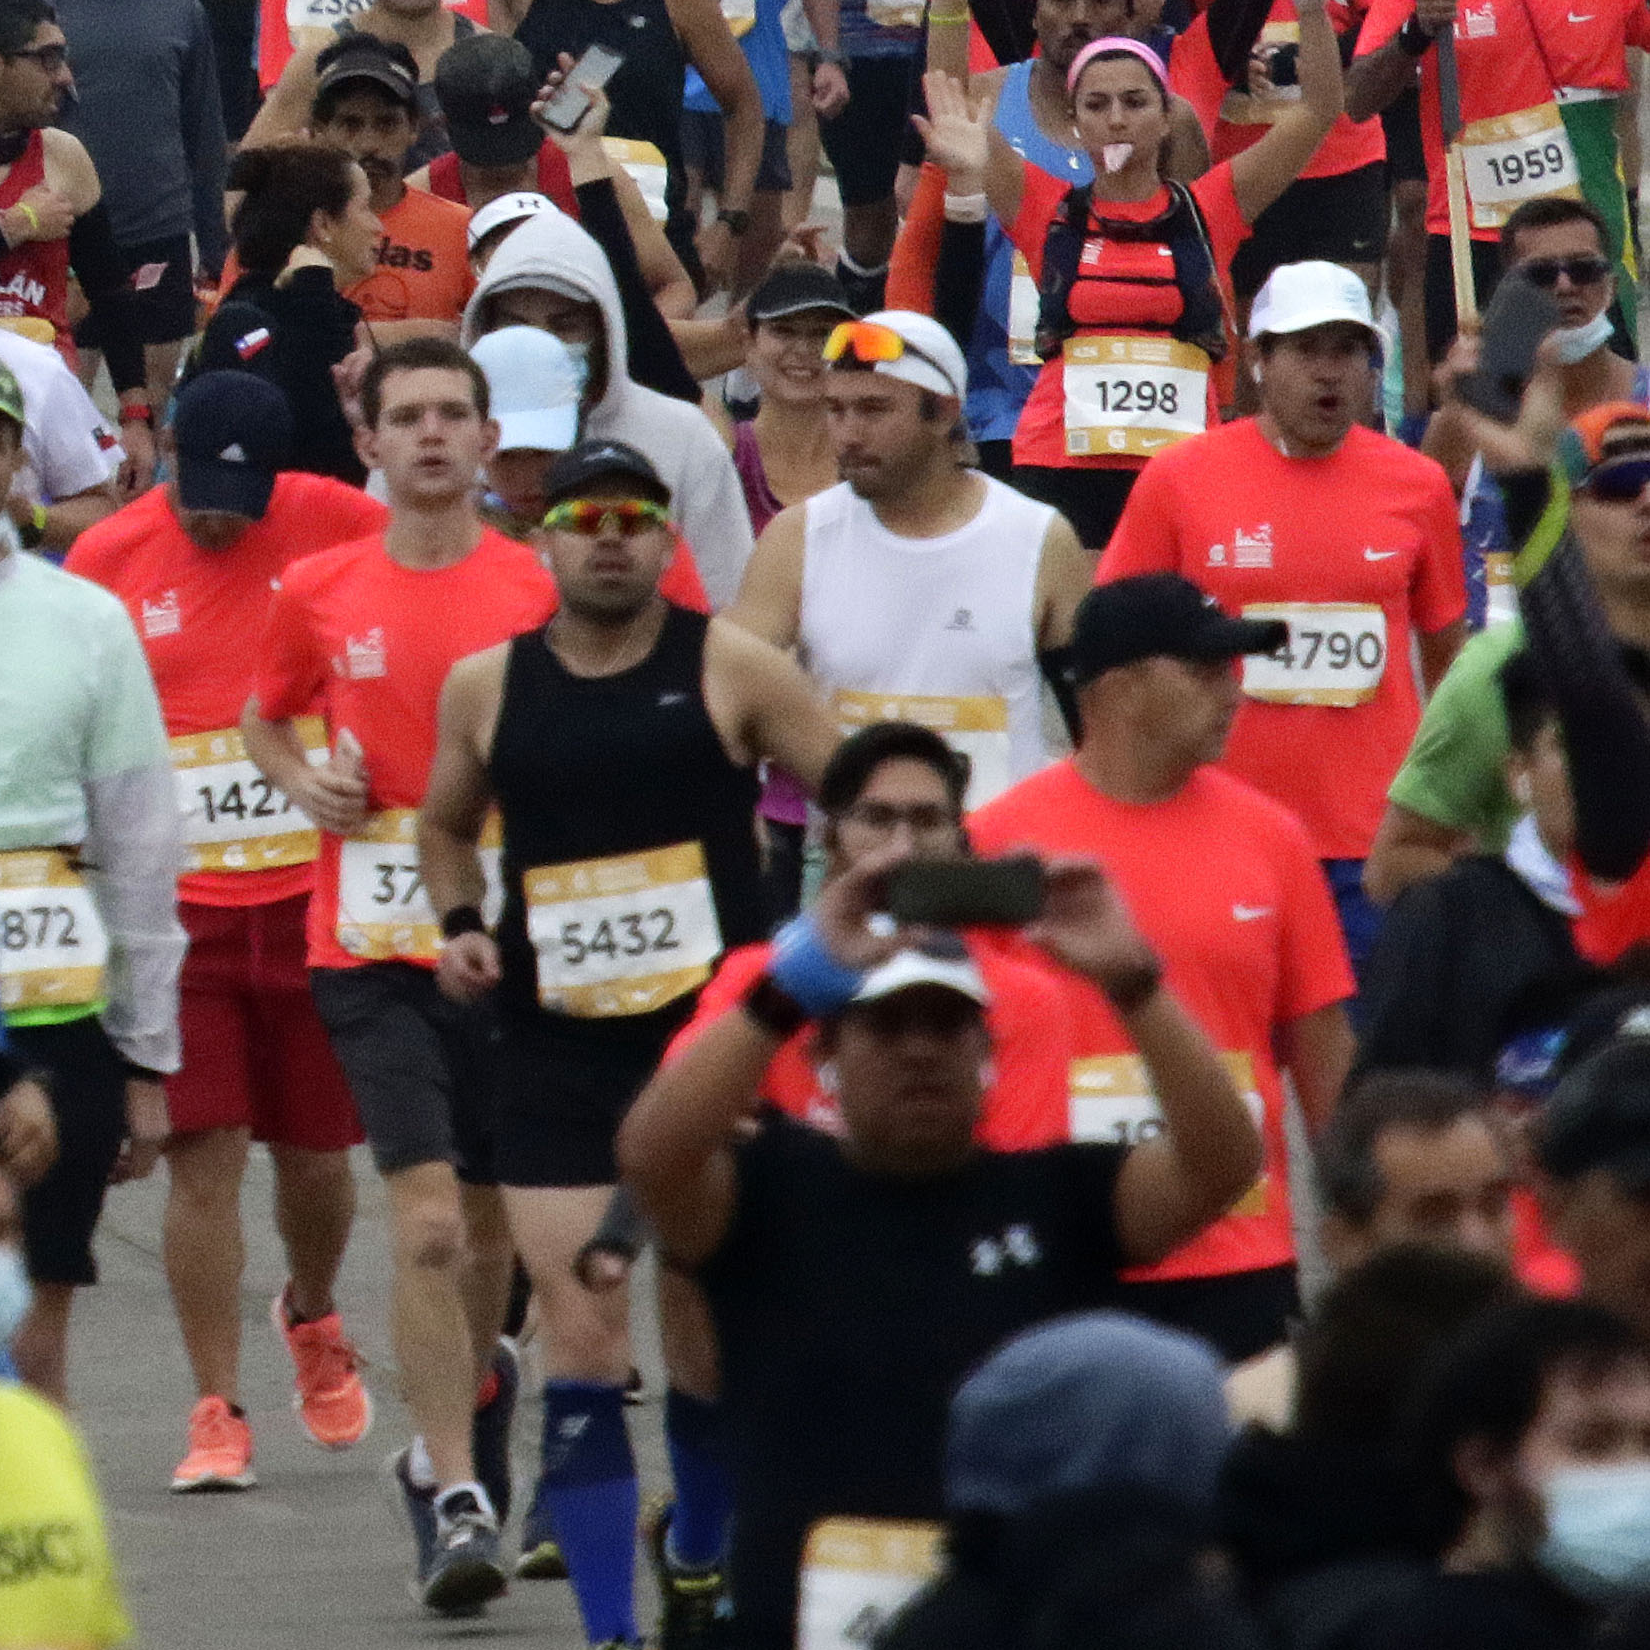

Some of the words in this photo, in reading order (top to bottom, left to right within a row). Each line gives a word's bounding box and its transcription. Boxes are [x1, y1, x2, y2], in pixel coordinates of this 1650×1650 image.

[1487, 143, 1565, 188] 1959
[1096, 380, 1179, 414] 1298
[371, 863, 425, 905] 37
[0, 906, 78, 952] 872
[559, 909, 681, 965] 5432
